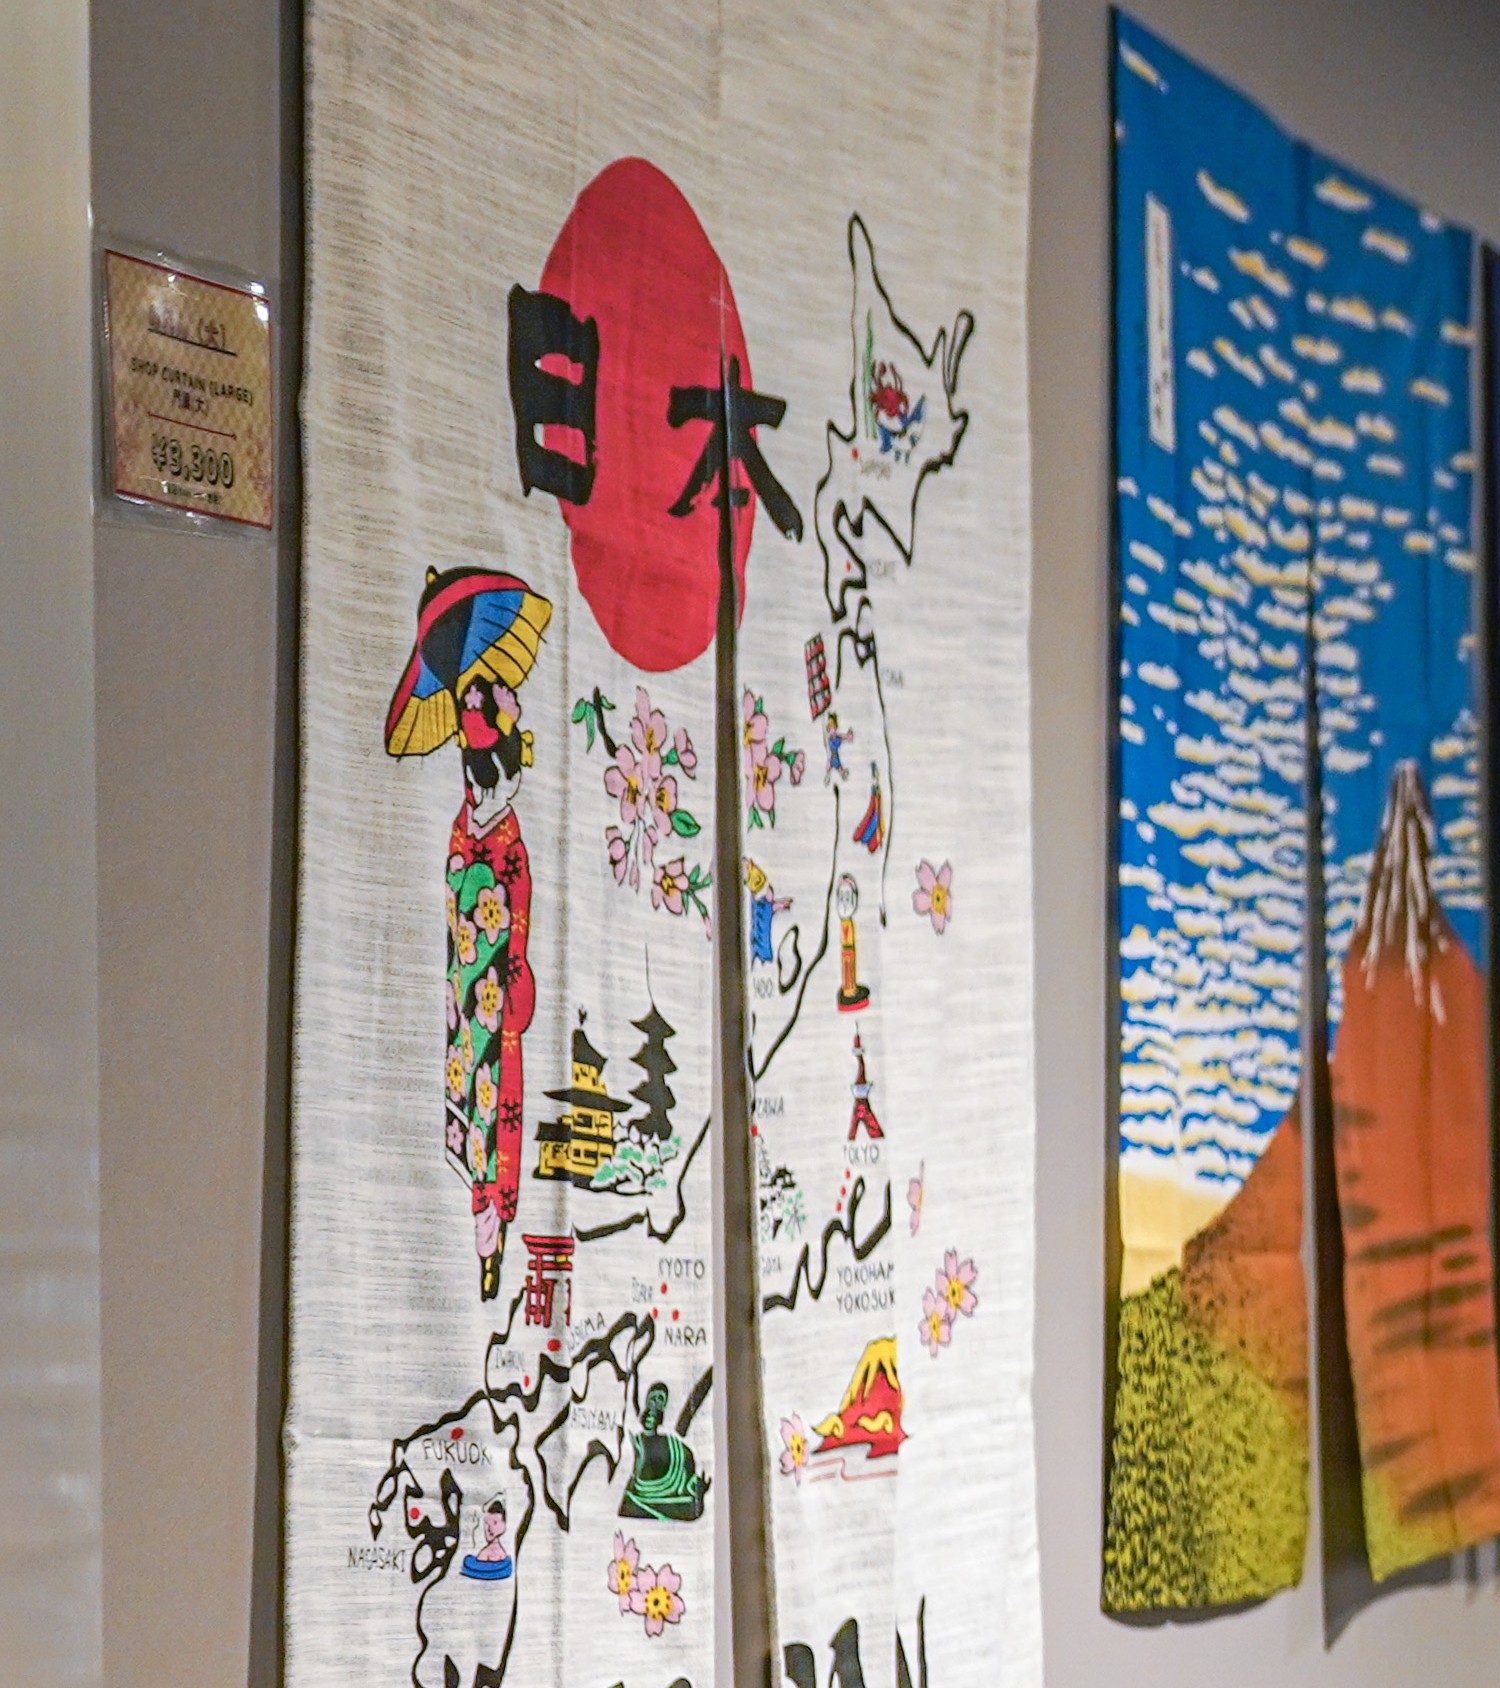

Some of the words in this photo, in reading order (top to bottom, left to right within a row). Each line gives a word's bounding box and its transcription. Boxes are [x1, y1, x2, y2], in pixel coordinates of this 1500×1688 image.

[131, 356, 158, 377] SHOP
[162, 365, 206, 394] CURTAIN
[507, 283, 804, 542] 日本
[152, 433, 233, 490] ¥3,300
[664, 1325, 708, 1347] NARA
[347, 1546, 406, 1573] NAGASAKI
